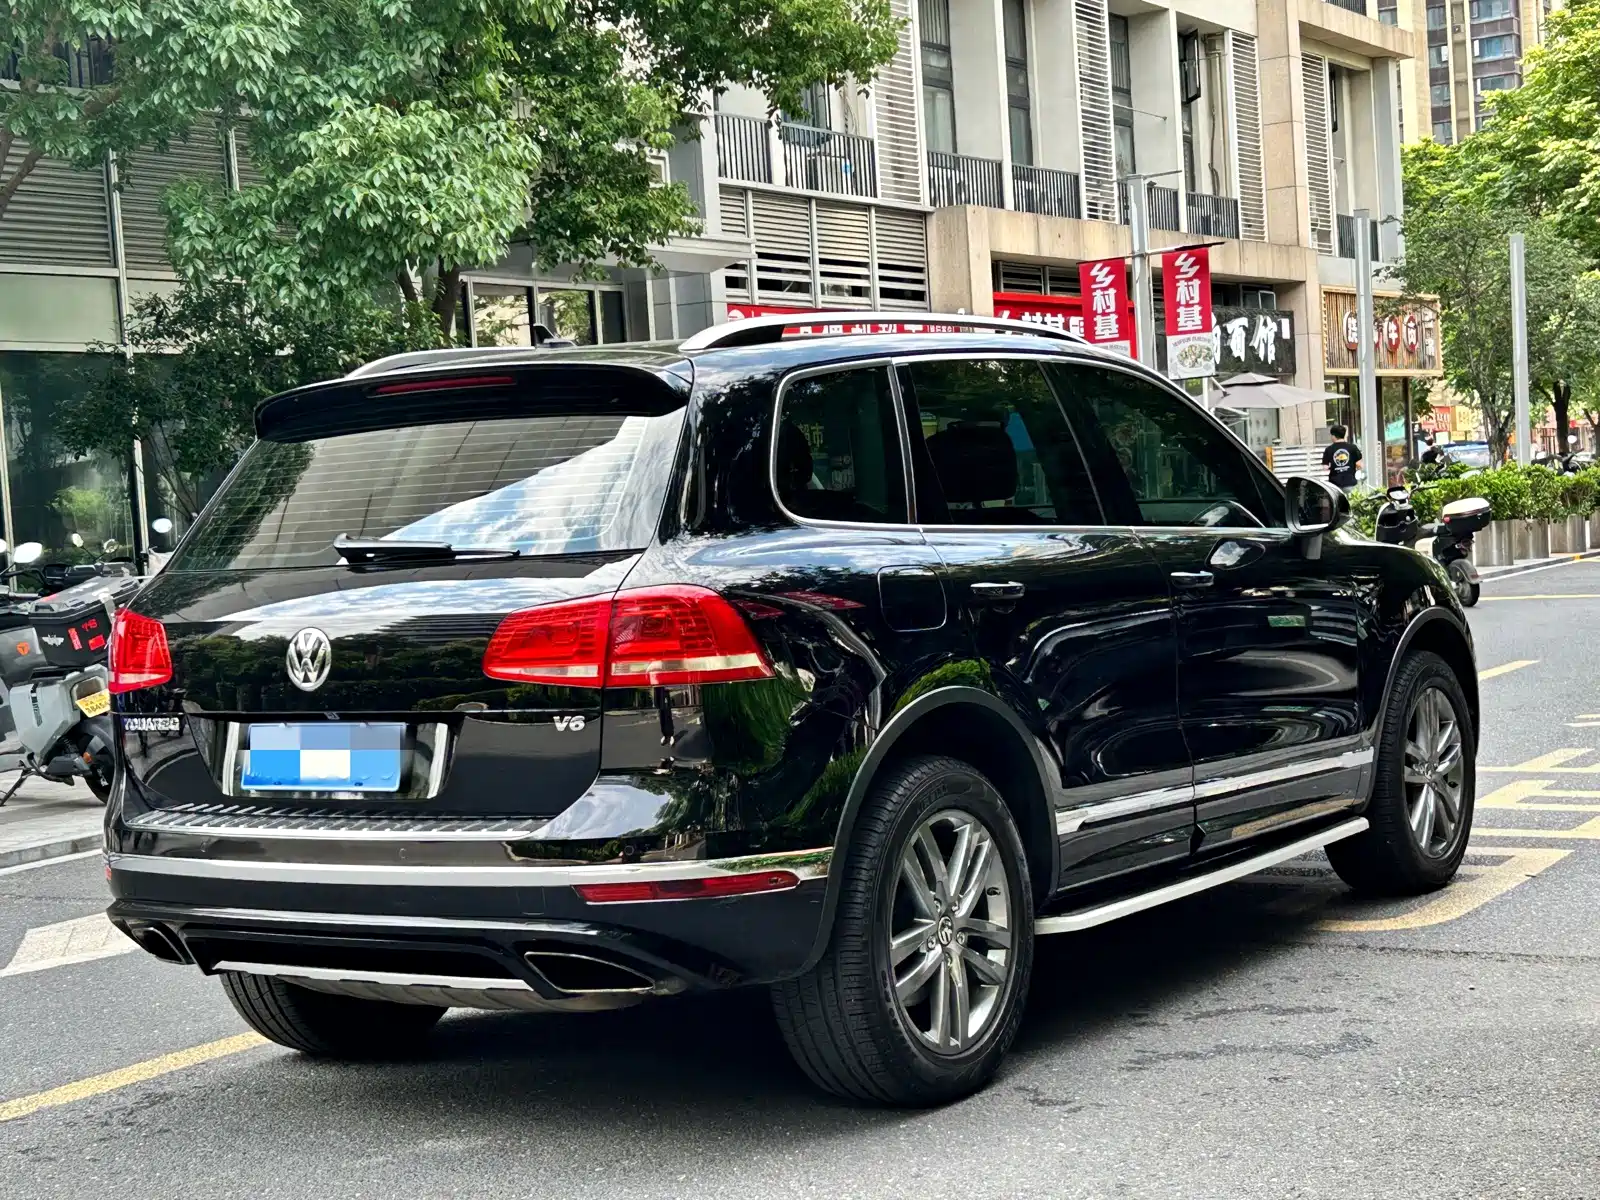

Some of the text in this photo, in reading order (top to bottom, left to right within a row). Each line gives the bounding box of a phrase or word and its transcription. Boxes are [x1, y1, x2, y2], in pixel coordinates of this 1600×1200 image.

[1089, 262, 1119, 340] 乡村基
[1174, 252, 1203, 332] 乡村基
[552, 715, 586, 732] V6
